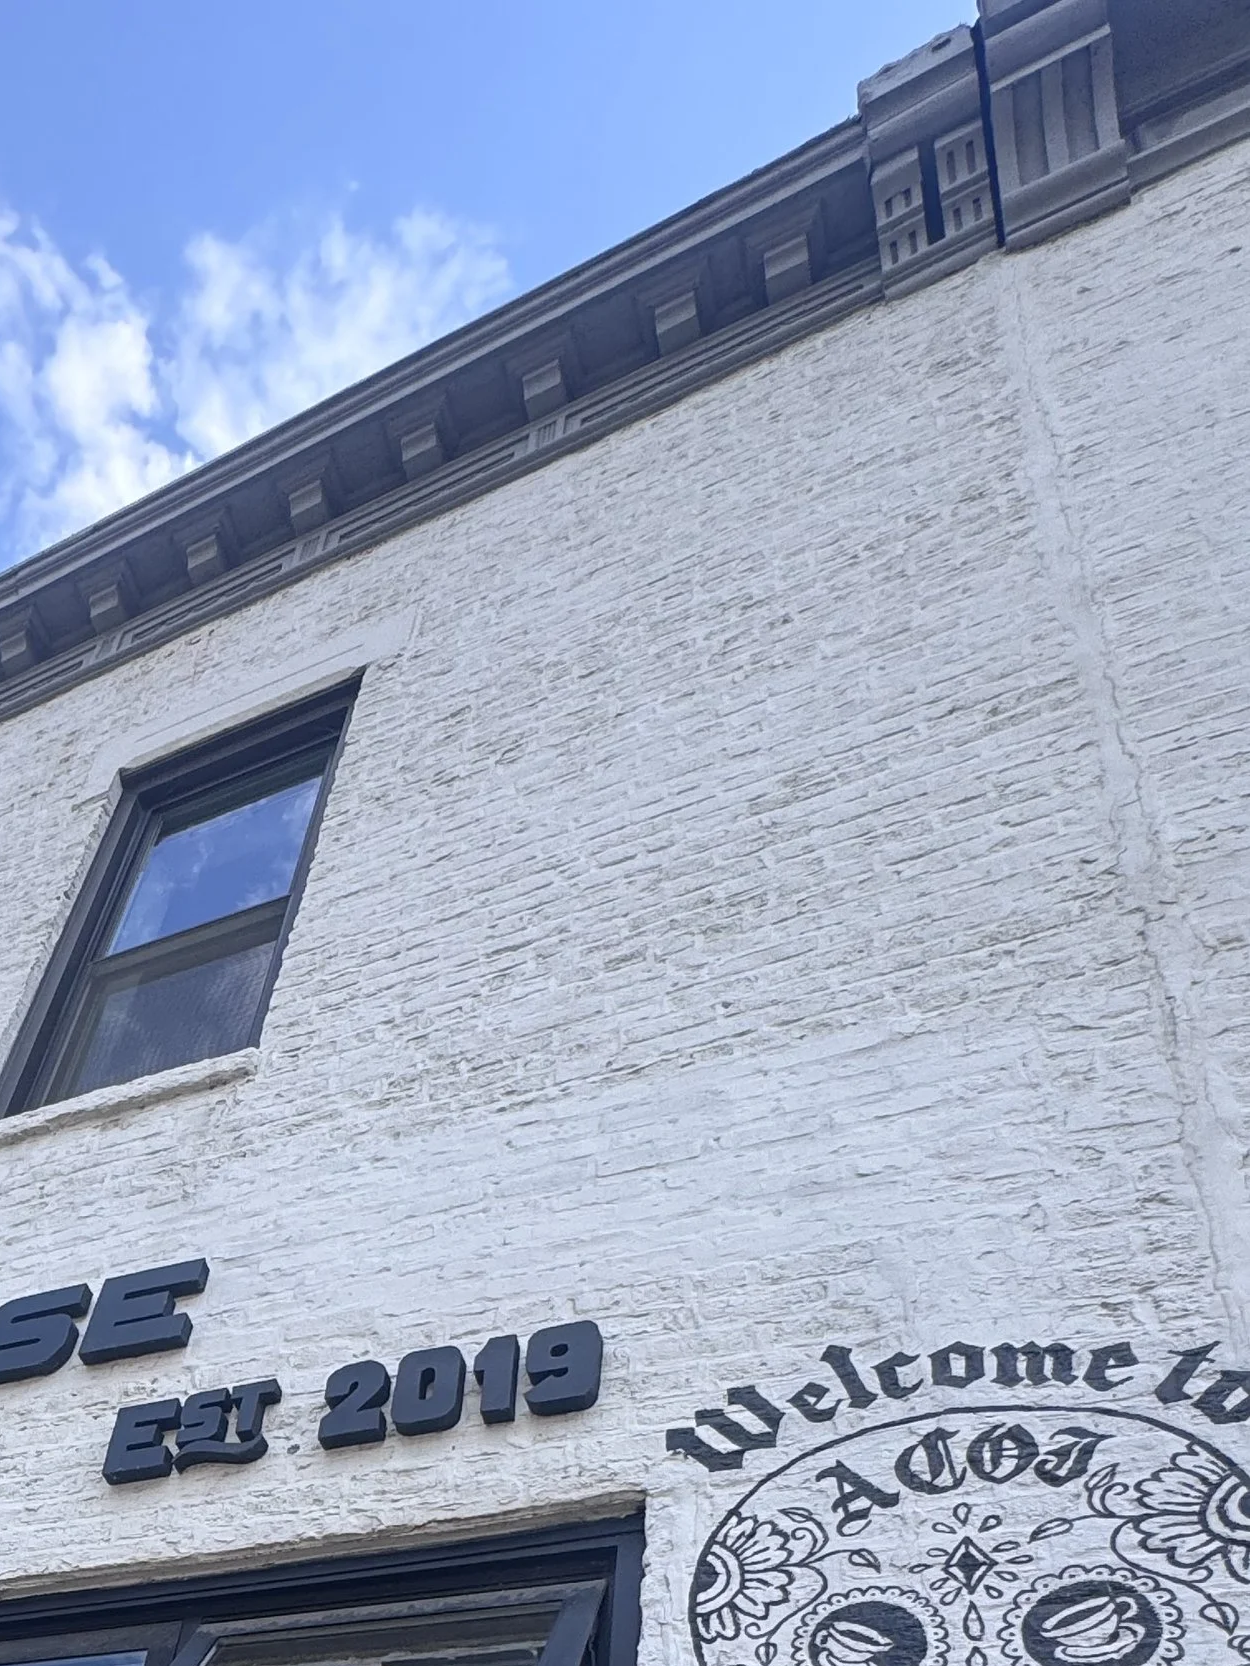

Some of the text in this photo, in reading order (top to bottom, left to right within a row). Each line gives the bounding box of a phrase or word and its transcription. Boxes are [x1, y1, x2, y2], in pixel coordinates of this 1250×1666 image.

[318, 1320, 603, 1450] 2019
[665, 1340, 1250, 1472] Welcome to
